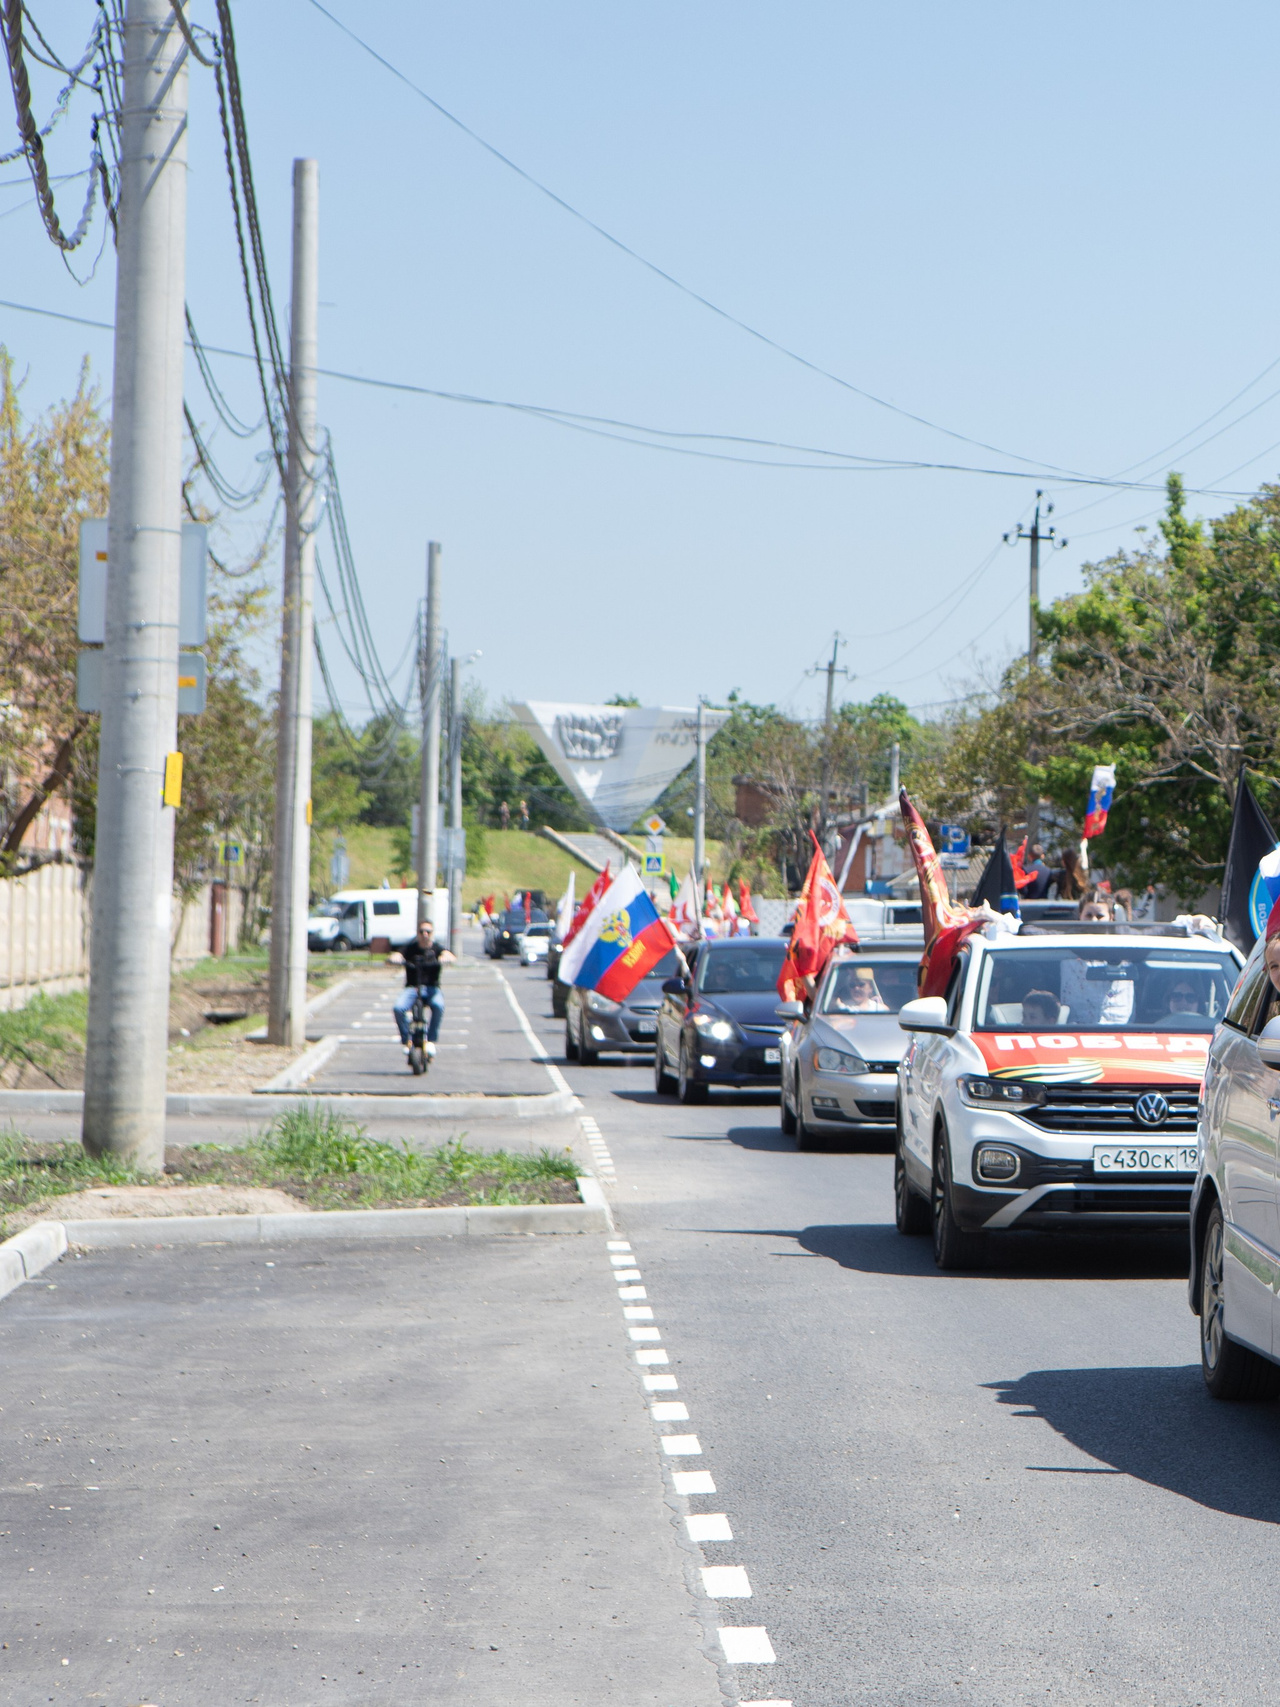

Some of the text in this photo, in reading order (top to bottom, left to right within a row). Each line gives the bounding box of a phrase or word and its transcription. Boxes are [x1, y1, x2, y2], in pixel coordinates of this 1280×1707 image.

[994, 1035, 1210, 1053] ПОБЕД
[1100, 1148, 1198, 1168] С430СК 19
